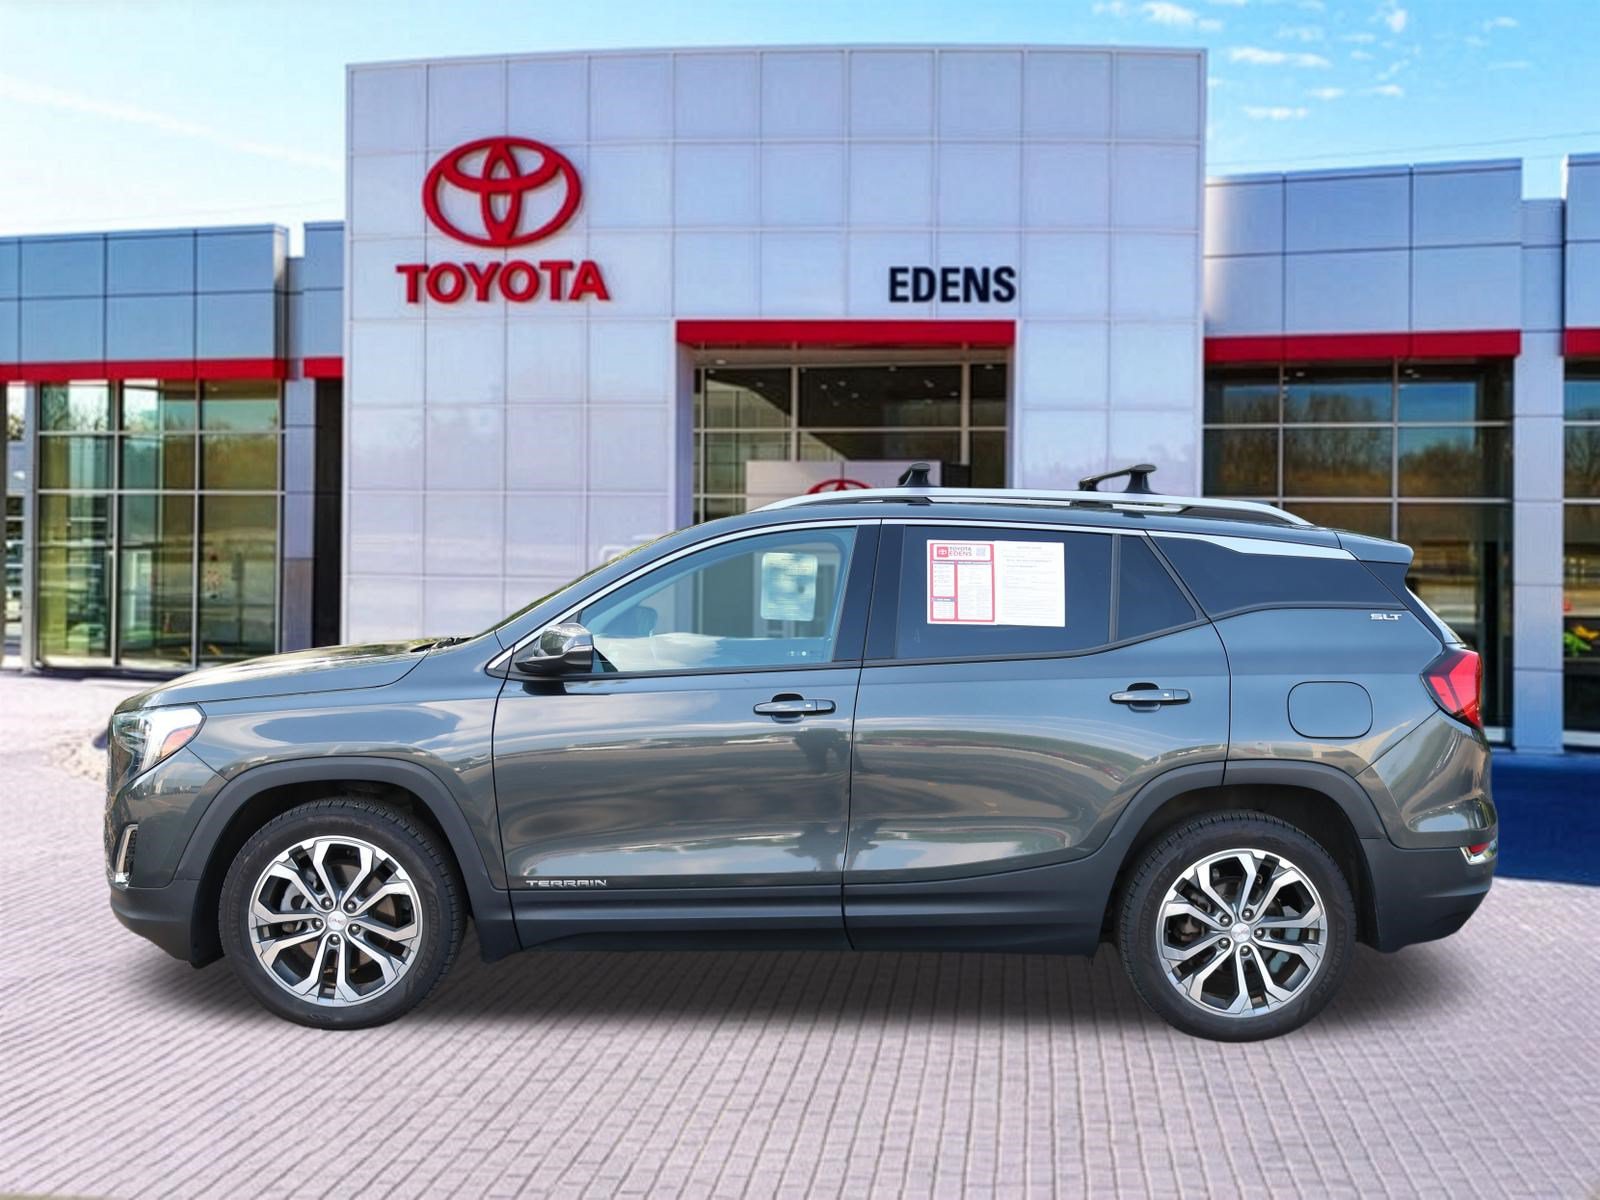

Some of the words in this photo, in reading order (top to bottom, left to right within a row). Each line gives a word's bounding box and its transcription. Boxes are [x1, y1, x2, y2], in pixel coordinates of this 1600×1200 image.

[396, 260, 611, 304] TOYOTA
[889, 266, 1016, 303] EDENS
[1370, 613, 1402, 621] SLT
[526, 879, 607, 888] TERRAIN
